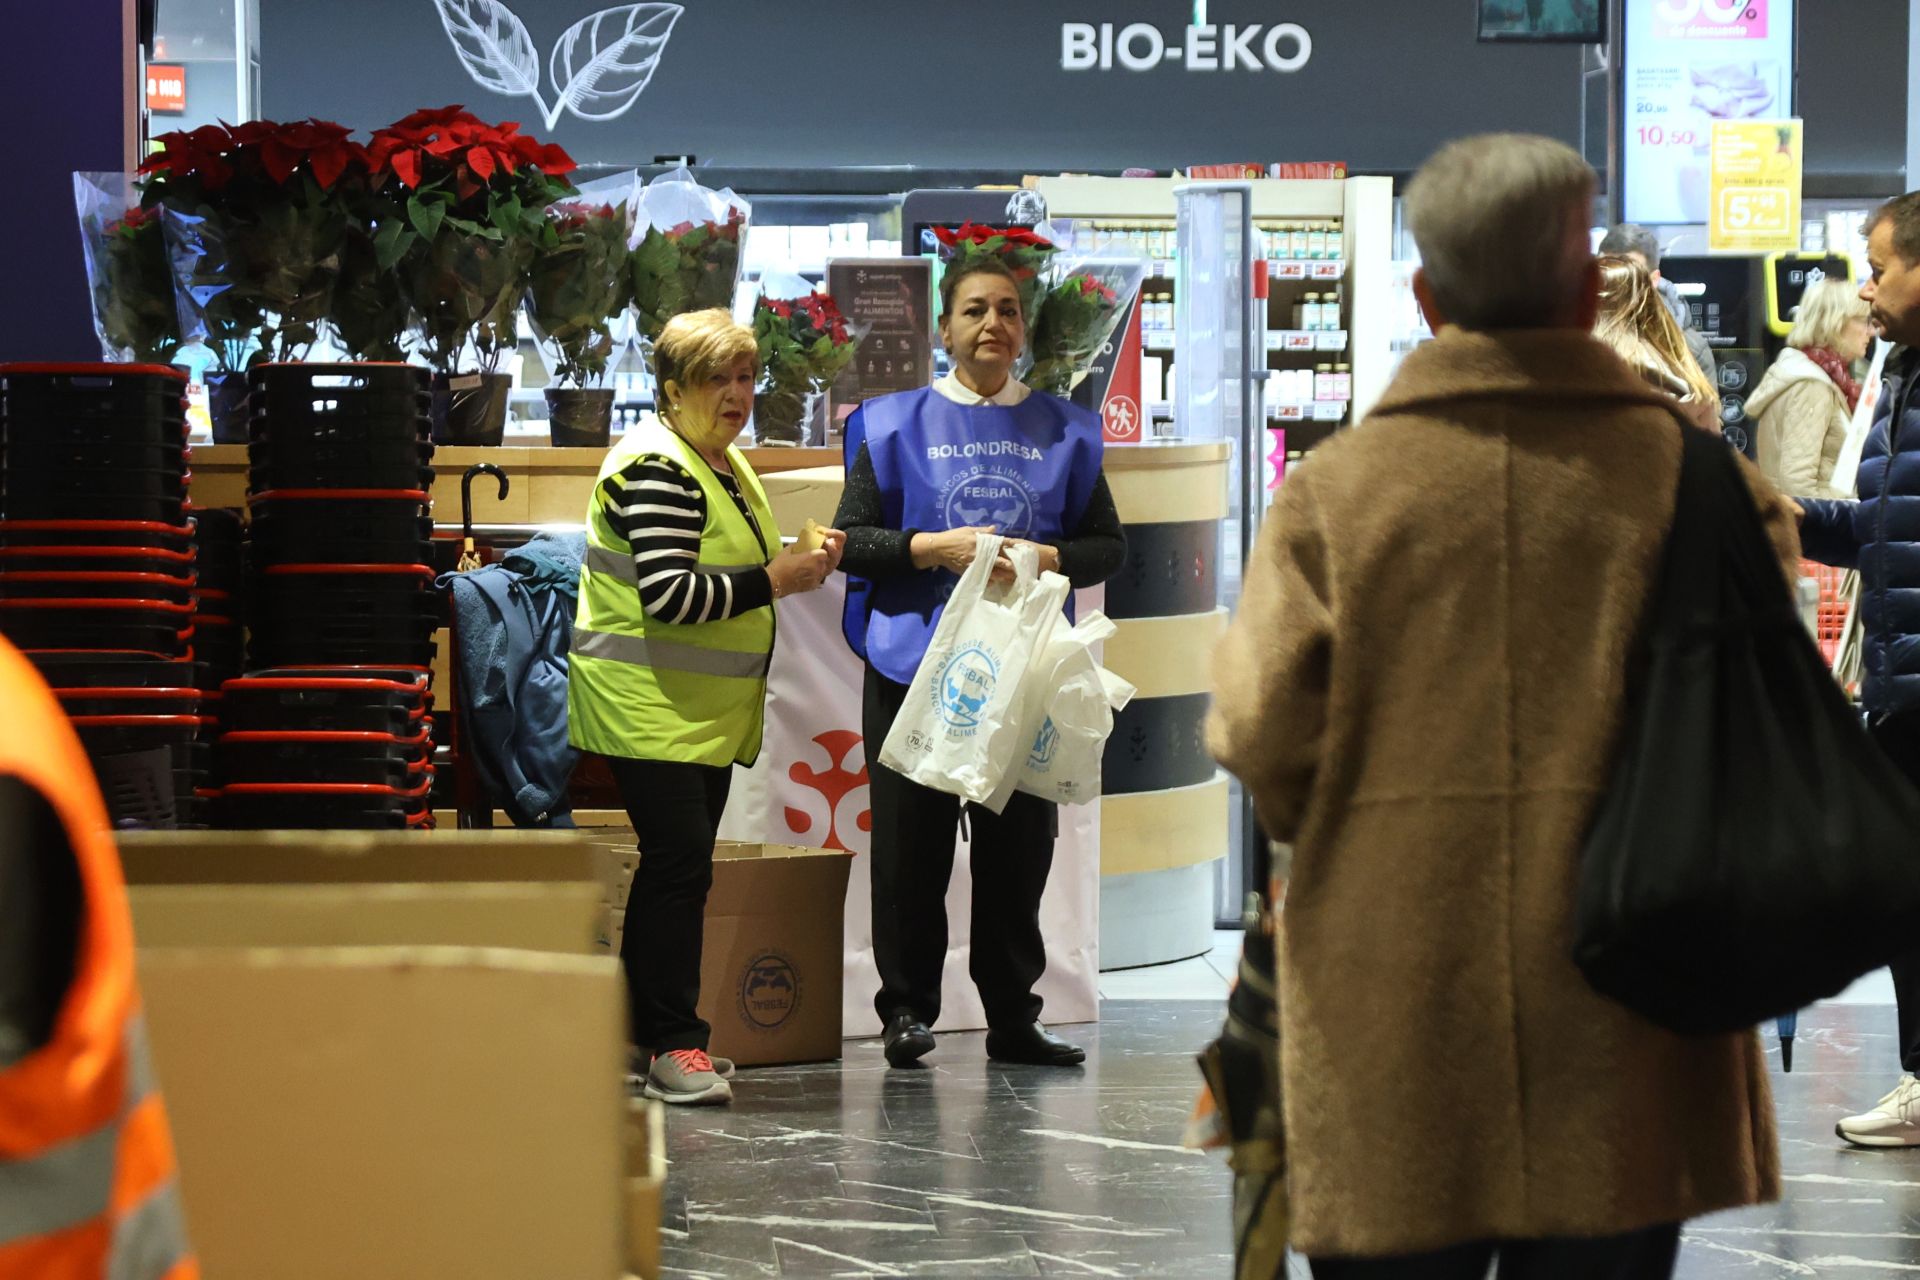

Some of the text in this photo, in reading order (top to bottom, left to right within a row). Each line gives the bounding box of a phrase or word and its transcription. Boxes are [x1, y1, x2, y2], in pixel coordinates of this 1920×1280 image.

[1061, 22, 1313, 72] BIO-EKO
[926, 440, 1044, 461] BOLONDRESA
[970, 464, 985, 475] DE
[963, 486, 1017, 499] FESBAL
